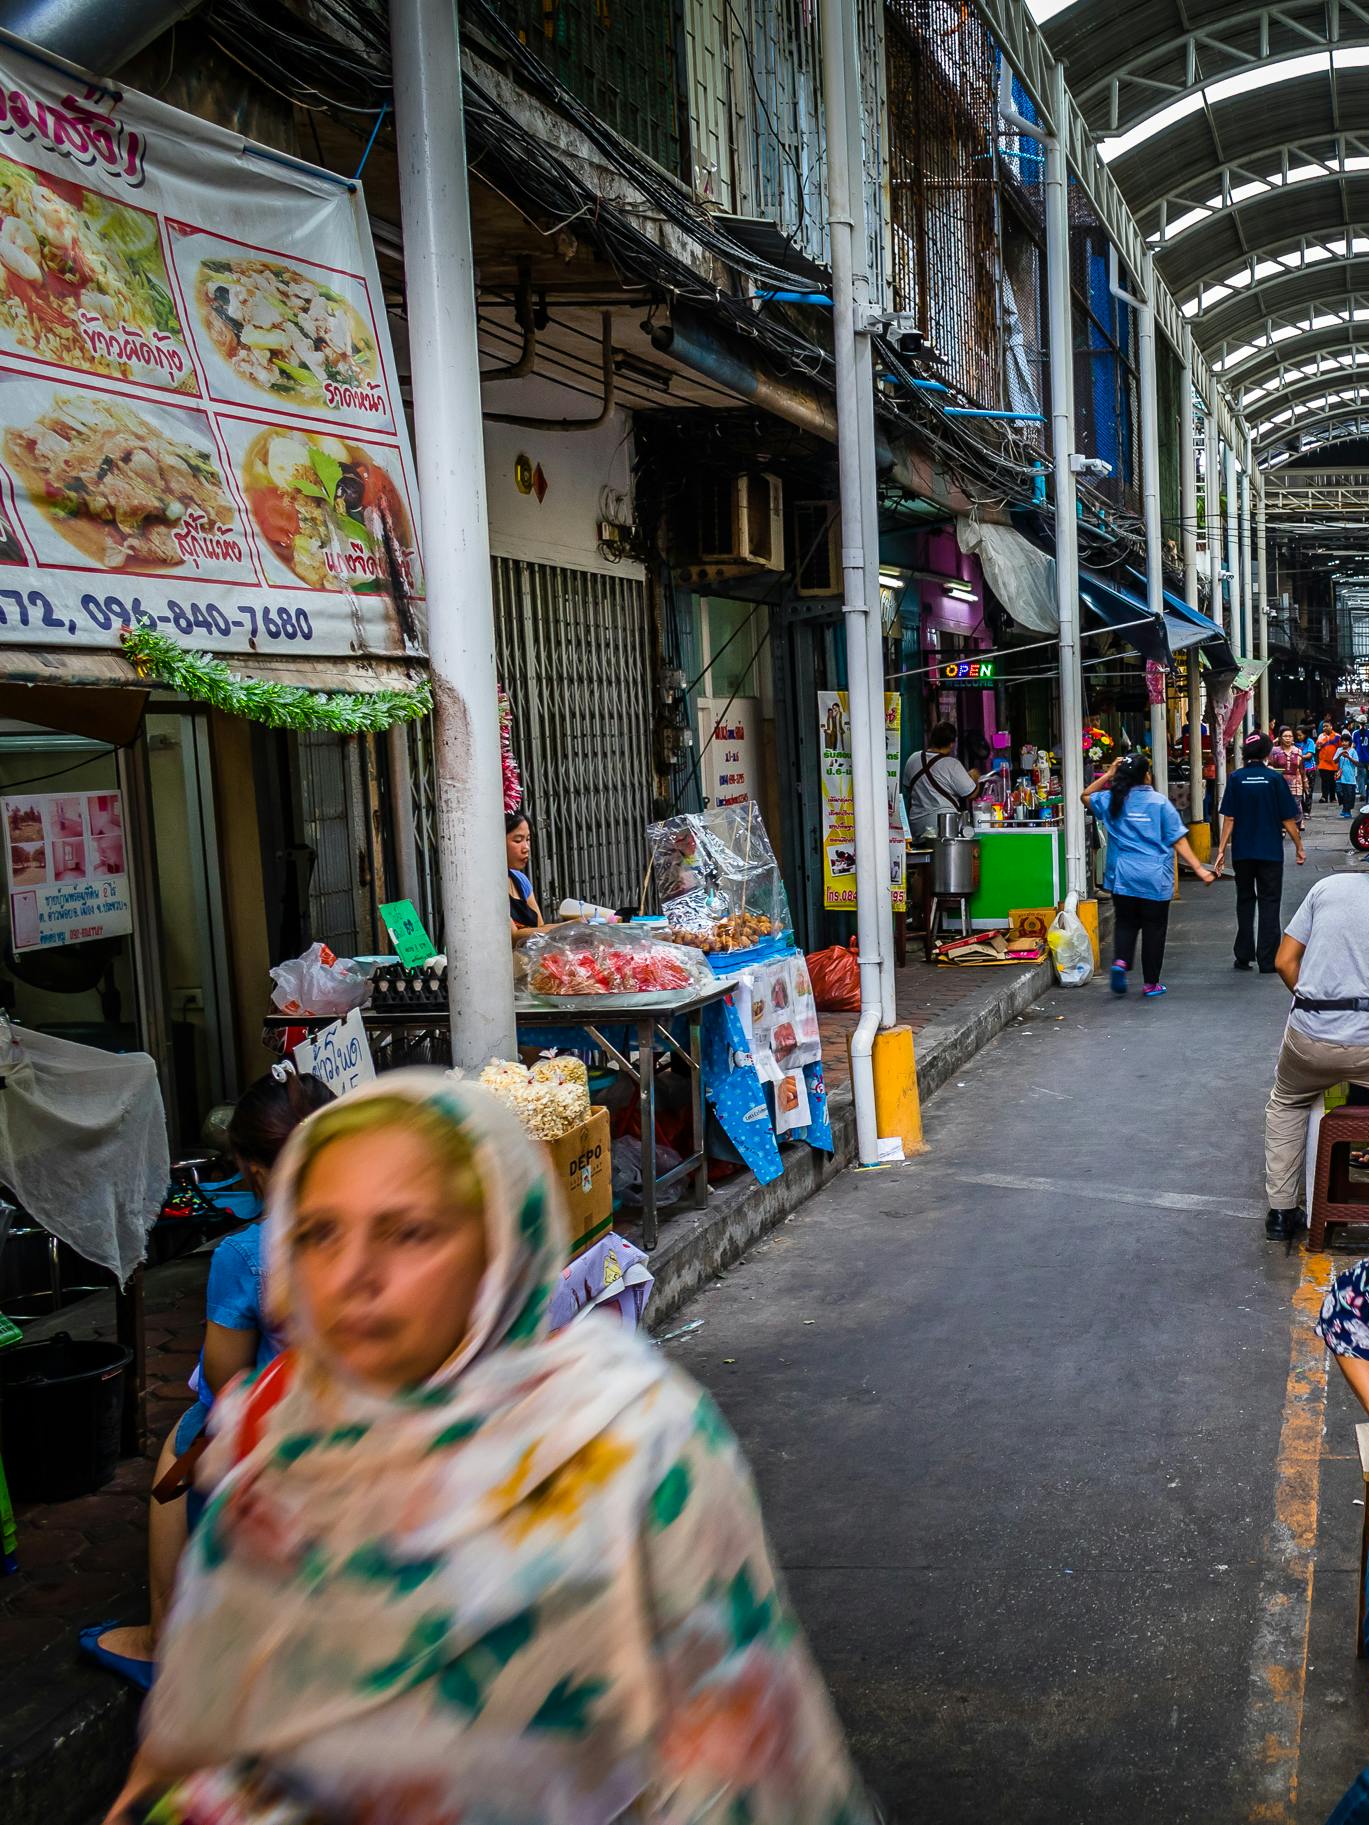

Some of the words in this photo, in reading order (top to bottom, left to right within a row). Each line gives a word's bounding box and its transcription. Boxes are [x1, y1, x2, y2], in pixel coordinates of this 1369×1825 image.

[79, 311, 184, 383] ข้าวผัดกุ้ง
[325, 381, 386, 416] ราดหน้า
[0, 589, 77, 636] 72,
[81, 593, 313, 641] 096-840-7680
[946, 664, 992, 677] OPEN
[570, 1145, 602, 1177] DEPO
